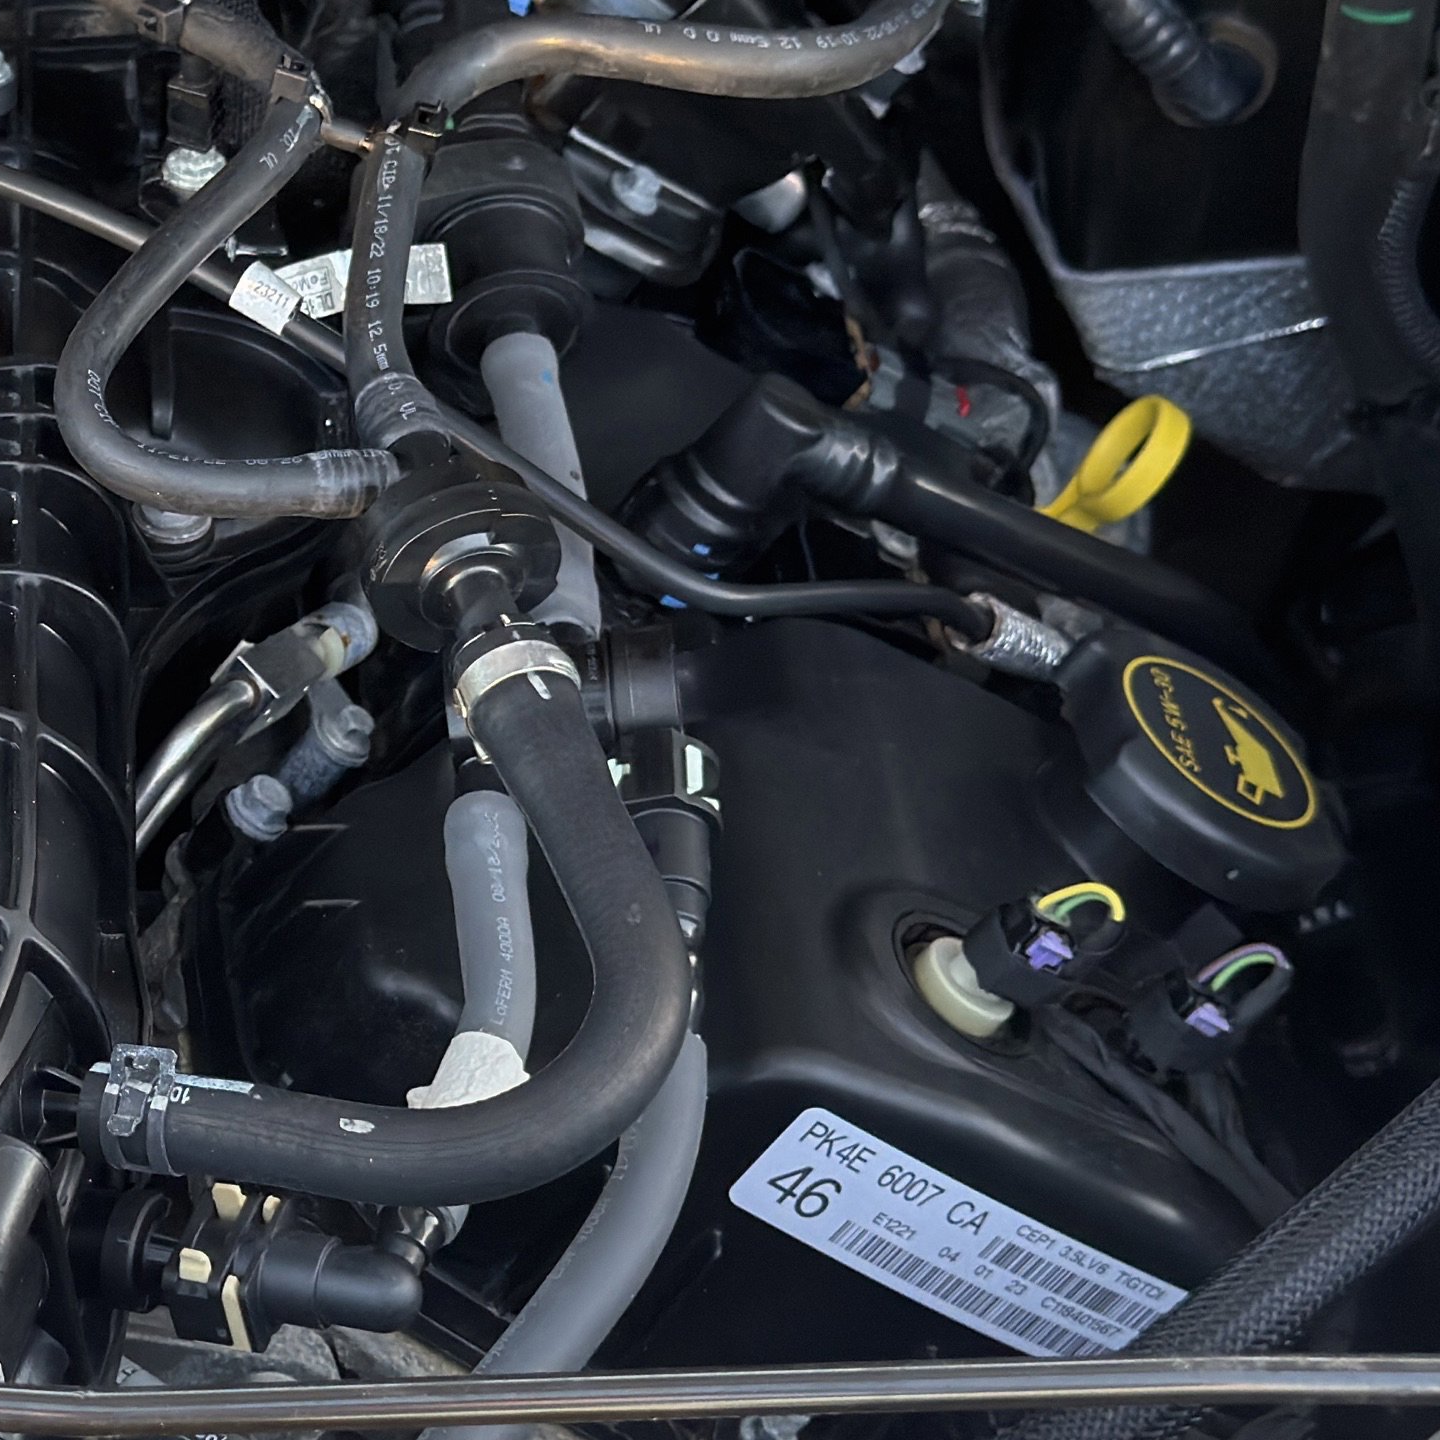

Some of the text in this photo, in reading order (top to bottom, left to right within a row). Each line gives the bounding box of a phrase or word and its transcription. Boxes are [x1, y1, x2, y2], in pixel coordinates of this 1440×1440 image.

[370, 193, 394, 259] 11/18/22
[365, 269, 381, 309] 10:19
[1171, 730, 1201, 772] SAE
[768, 1165, 843, 1218] 46
[799, 1120, 991, 1236] PK4E 6007 CA
[872, 1211, 917, 1241] E1221
[938, 1246, 957, 1263] 04
[974, 1264, 993, 1280] 01
[1004, 1279, 1028, 1296] 23
[1016, 1224, 1057, 1249] CEP1
